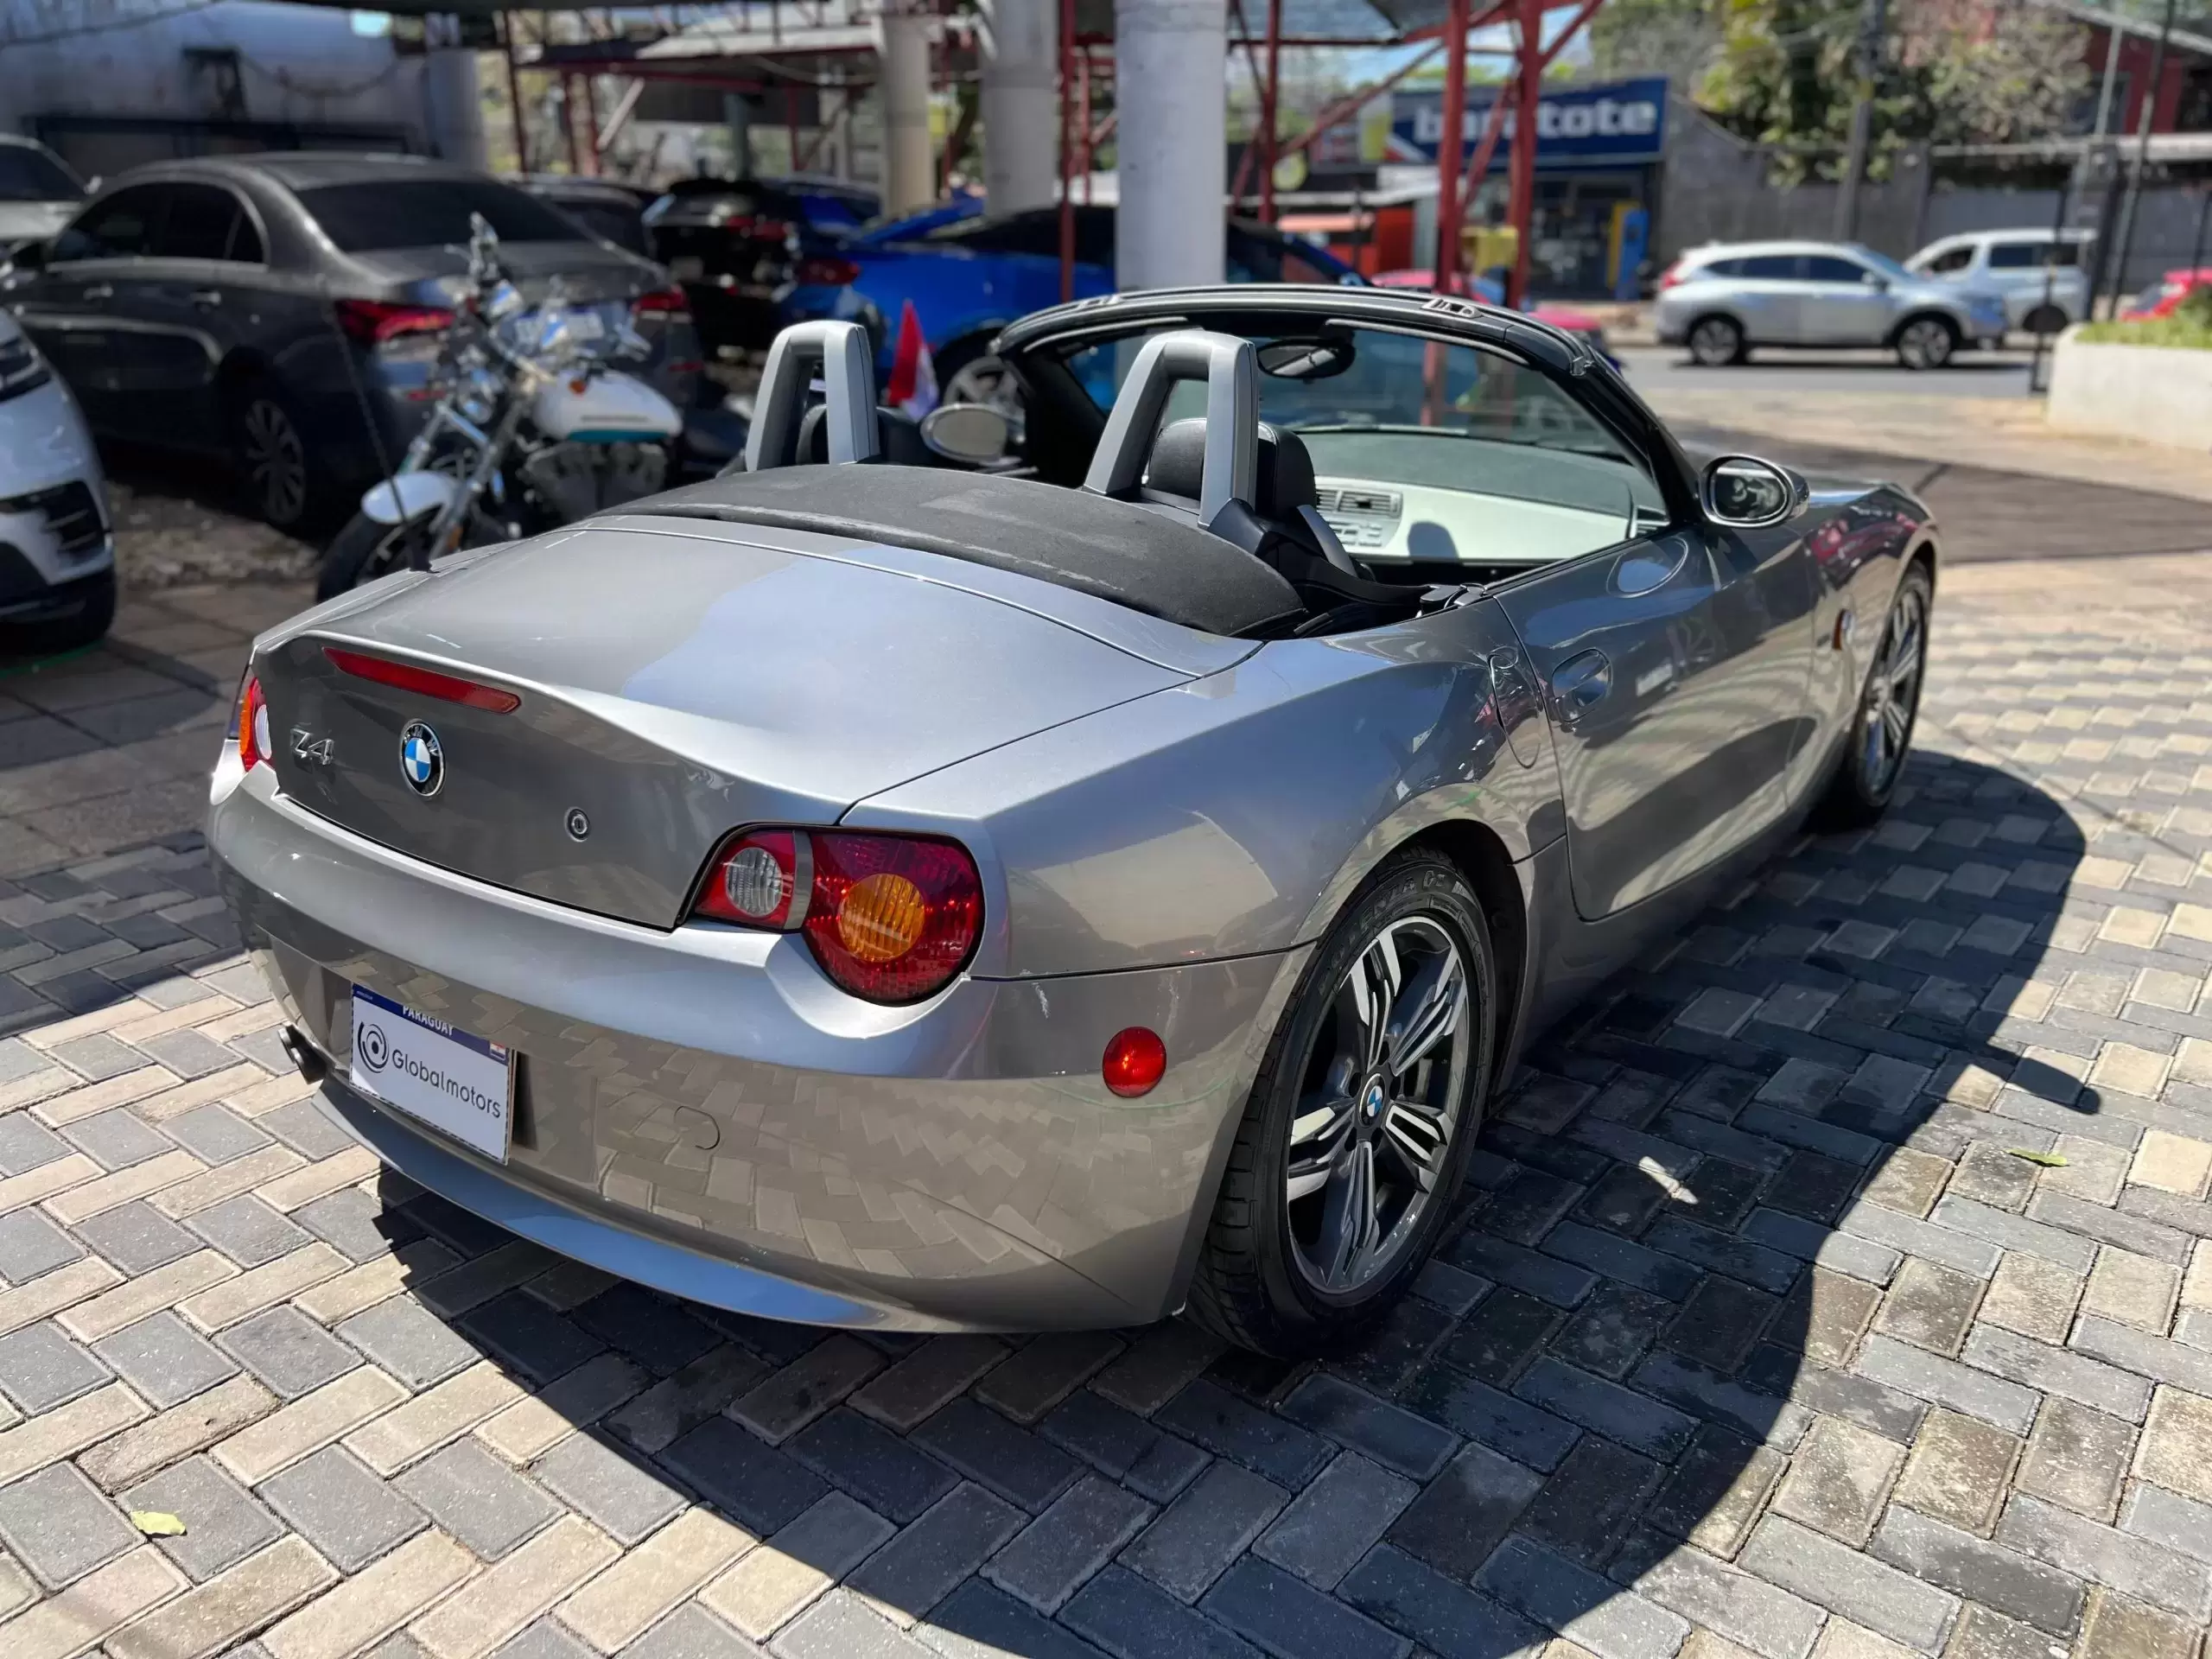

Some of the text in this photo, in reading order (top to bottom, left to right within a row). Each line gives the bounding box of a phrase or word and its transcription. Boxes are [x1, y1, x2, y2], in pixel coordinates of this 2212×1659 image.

[290, 727, 334, 765] Z4
[403, 1005, 454, 1036] PARAGUAY
[392, 1049, 501, 1118] Globalmotors
